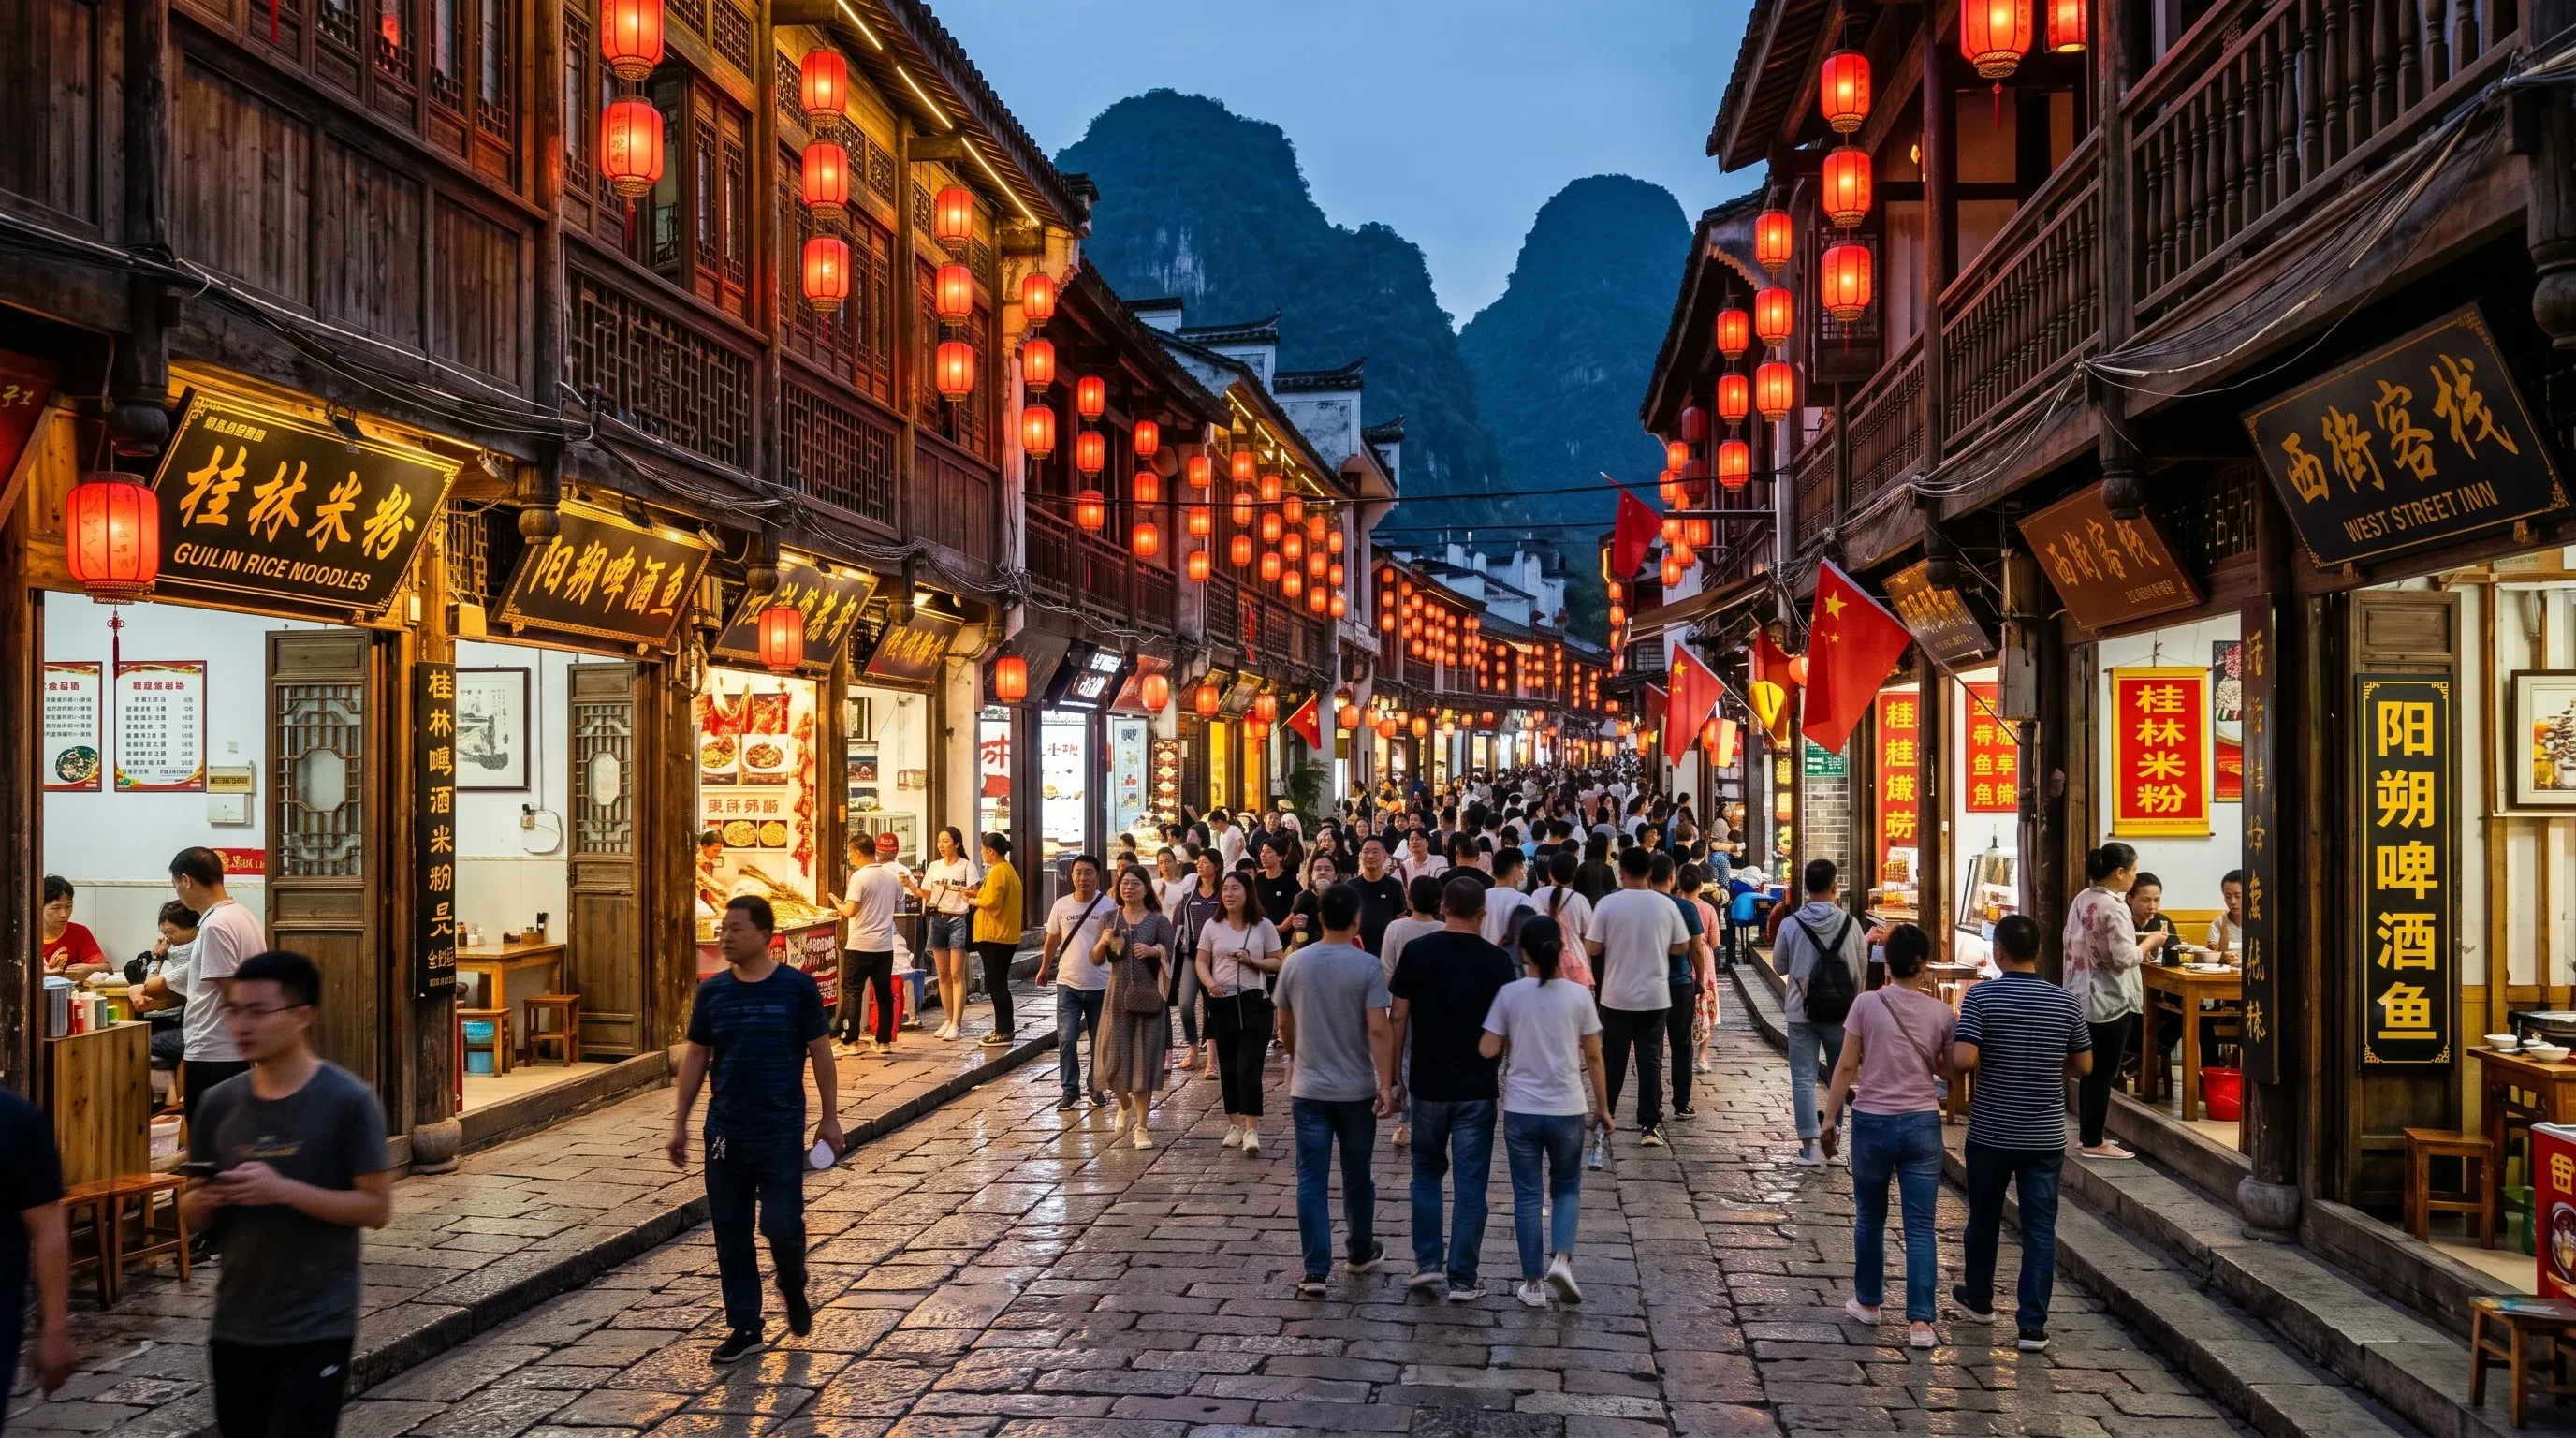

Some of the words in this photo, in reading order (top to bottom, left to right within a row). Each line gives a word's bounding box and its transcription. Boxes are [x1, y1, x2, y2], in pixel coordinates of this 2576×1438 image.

[179, 444, 415, 561] 桂林米粉
[2343, 511, 2391, 543] WEST
[2391, 491, 2459, 532] STREET
[2458, 480, 2499, 513] INN
[174, 542, 244, 571] GUILIN
[243, 553, 290, 579] RICE
[288, 562, 371, 591] NOODLES
[528, 535, 686, 617] 阳朔啤酒鱼
[2136, 684, 2187, 813] 桂林米粉
[2375, 700, 2438, 1040] 阳朔啤酒鱼
